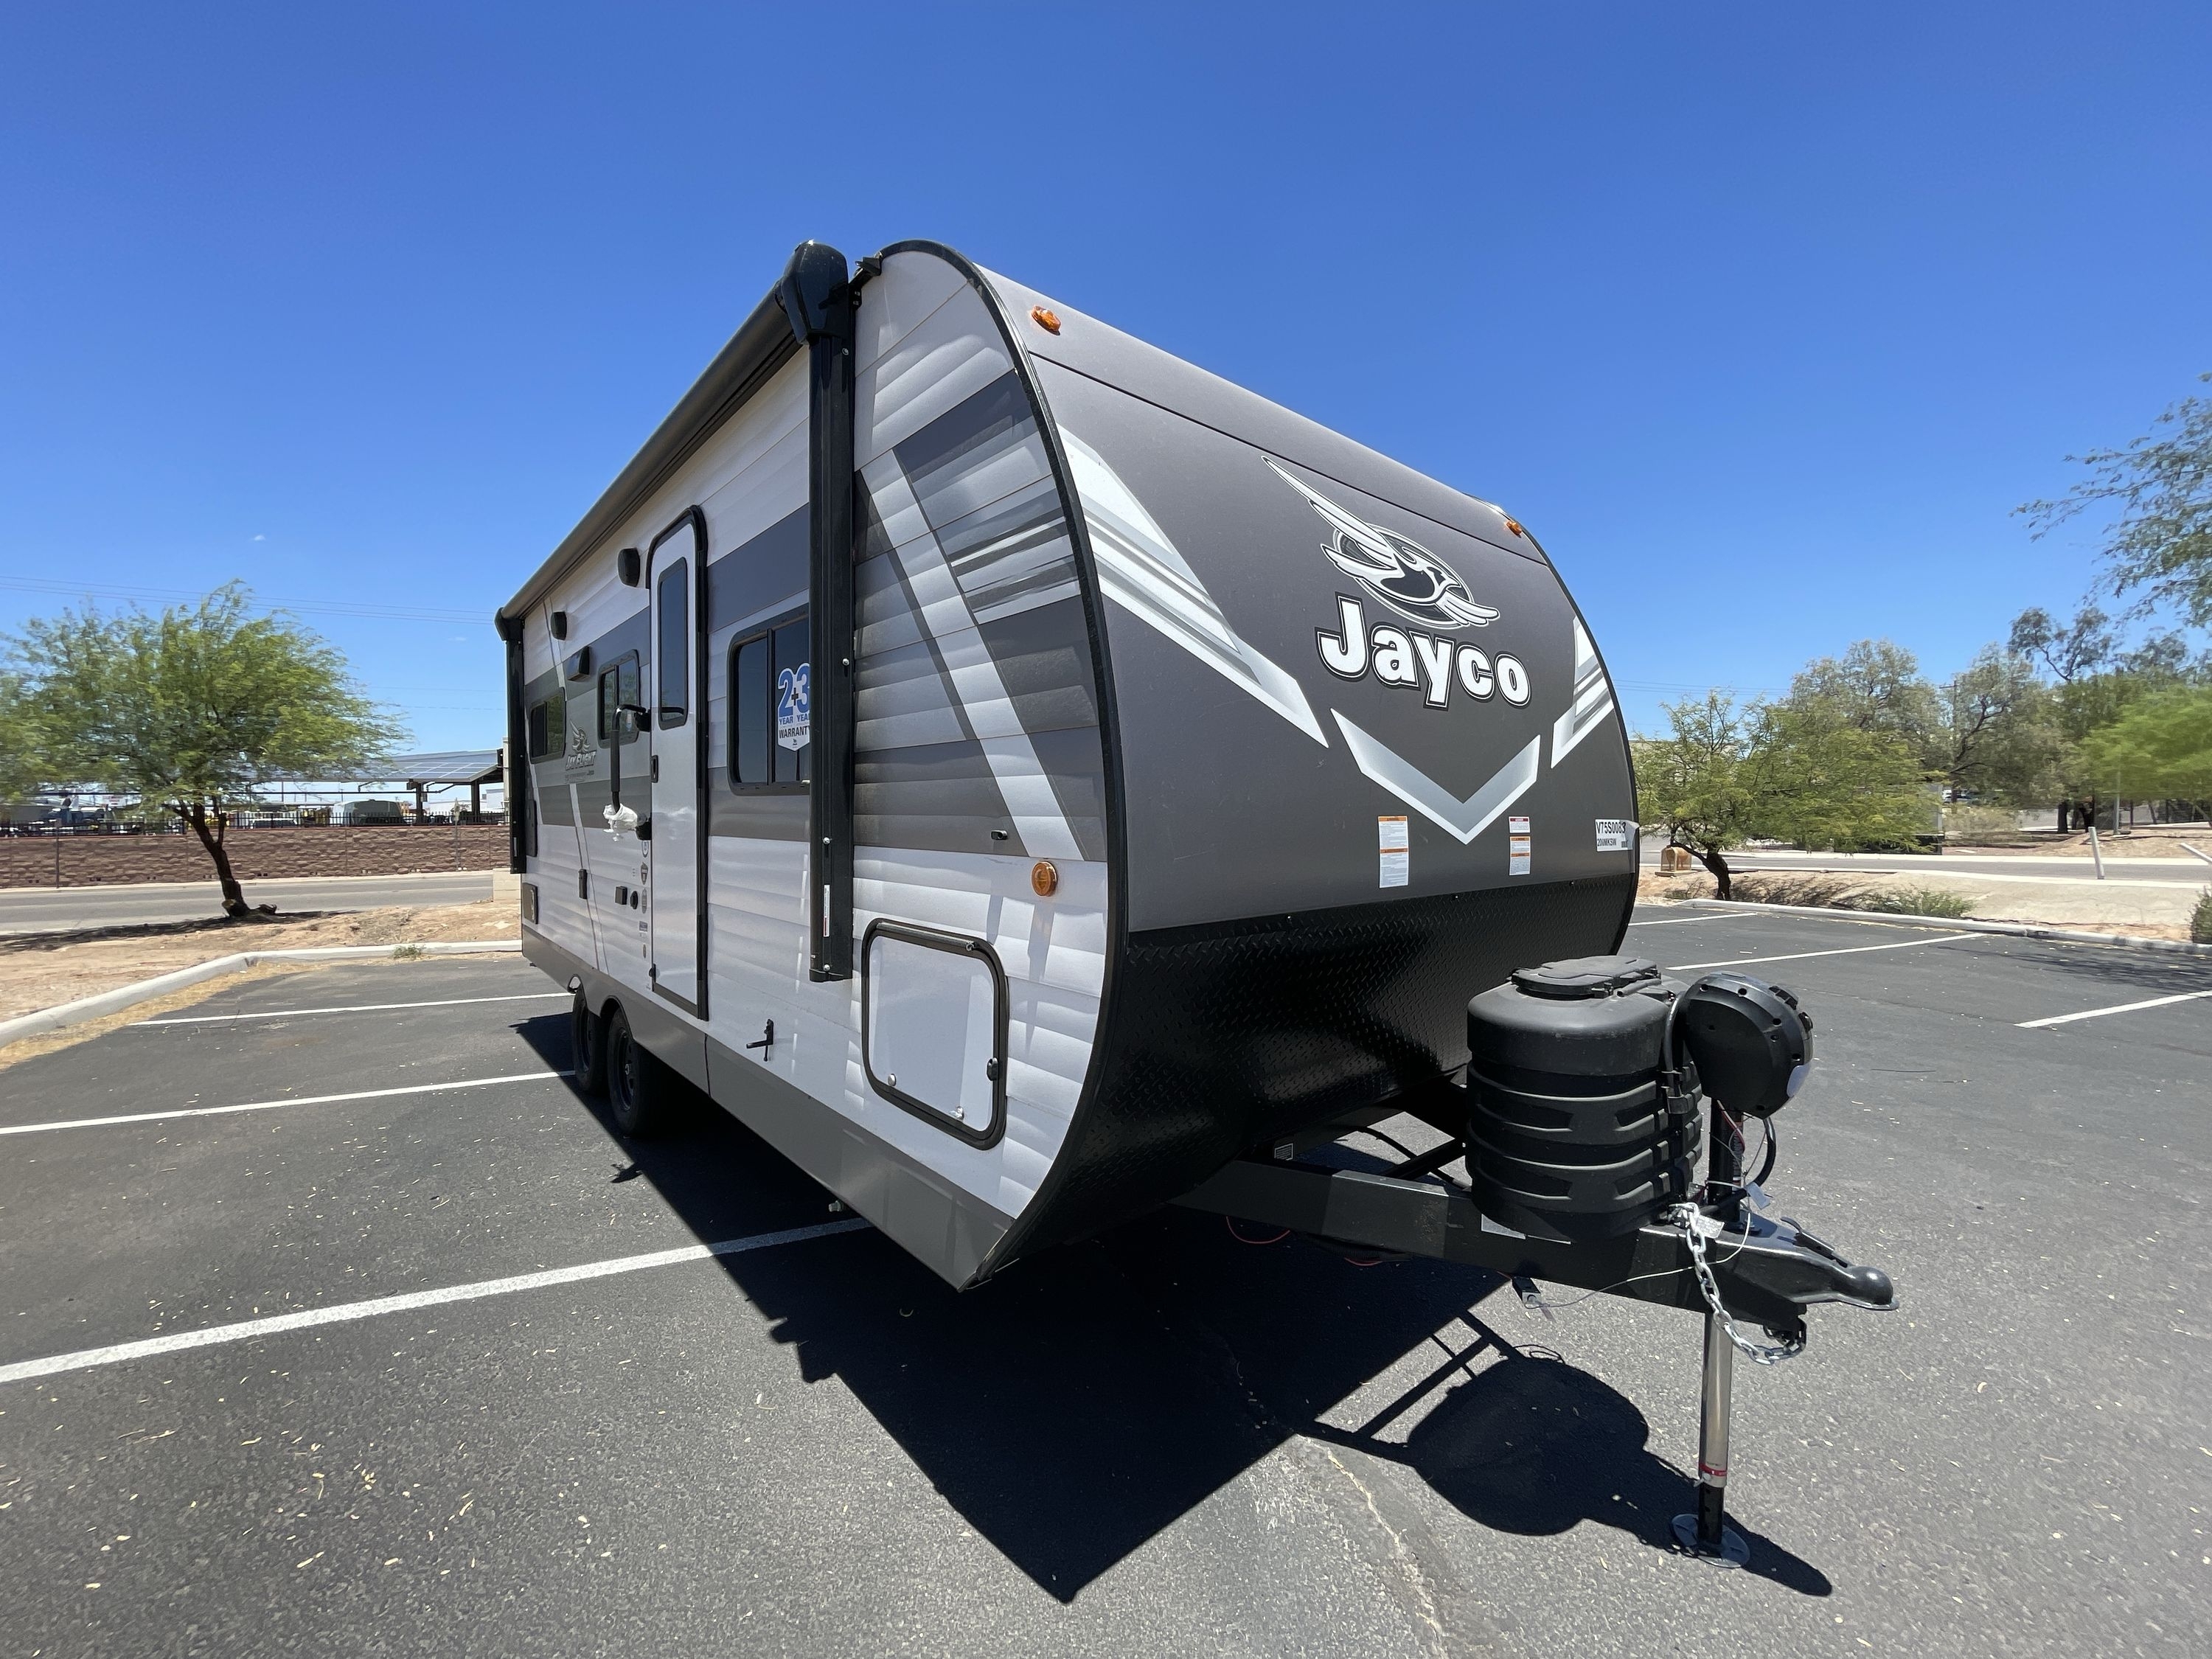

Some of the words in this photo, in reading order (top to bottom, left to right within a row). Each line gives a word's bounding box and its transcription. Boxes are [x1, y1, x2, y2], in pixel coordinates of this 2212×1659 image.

[1315, 593, 1532, 710] Jayco
[779, 717, 793, 725] YEAR
[797, 713, 810, 722] YEA
[566, 754, 577, 771] JAY
[576, 750, 596, 768] FLIGHT
